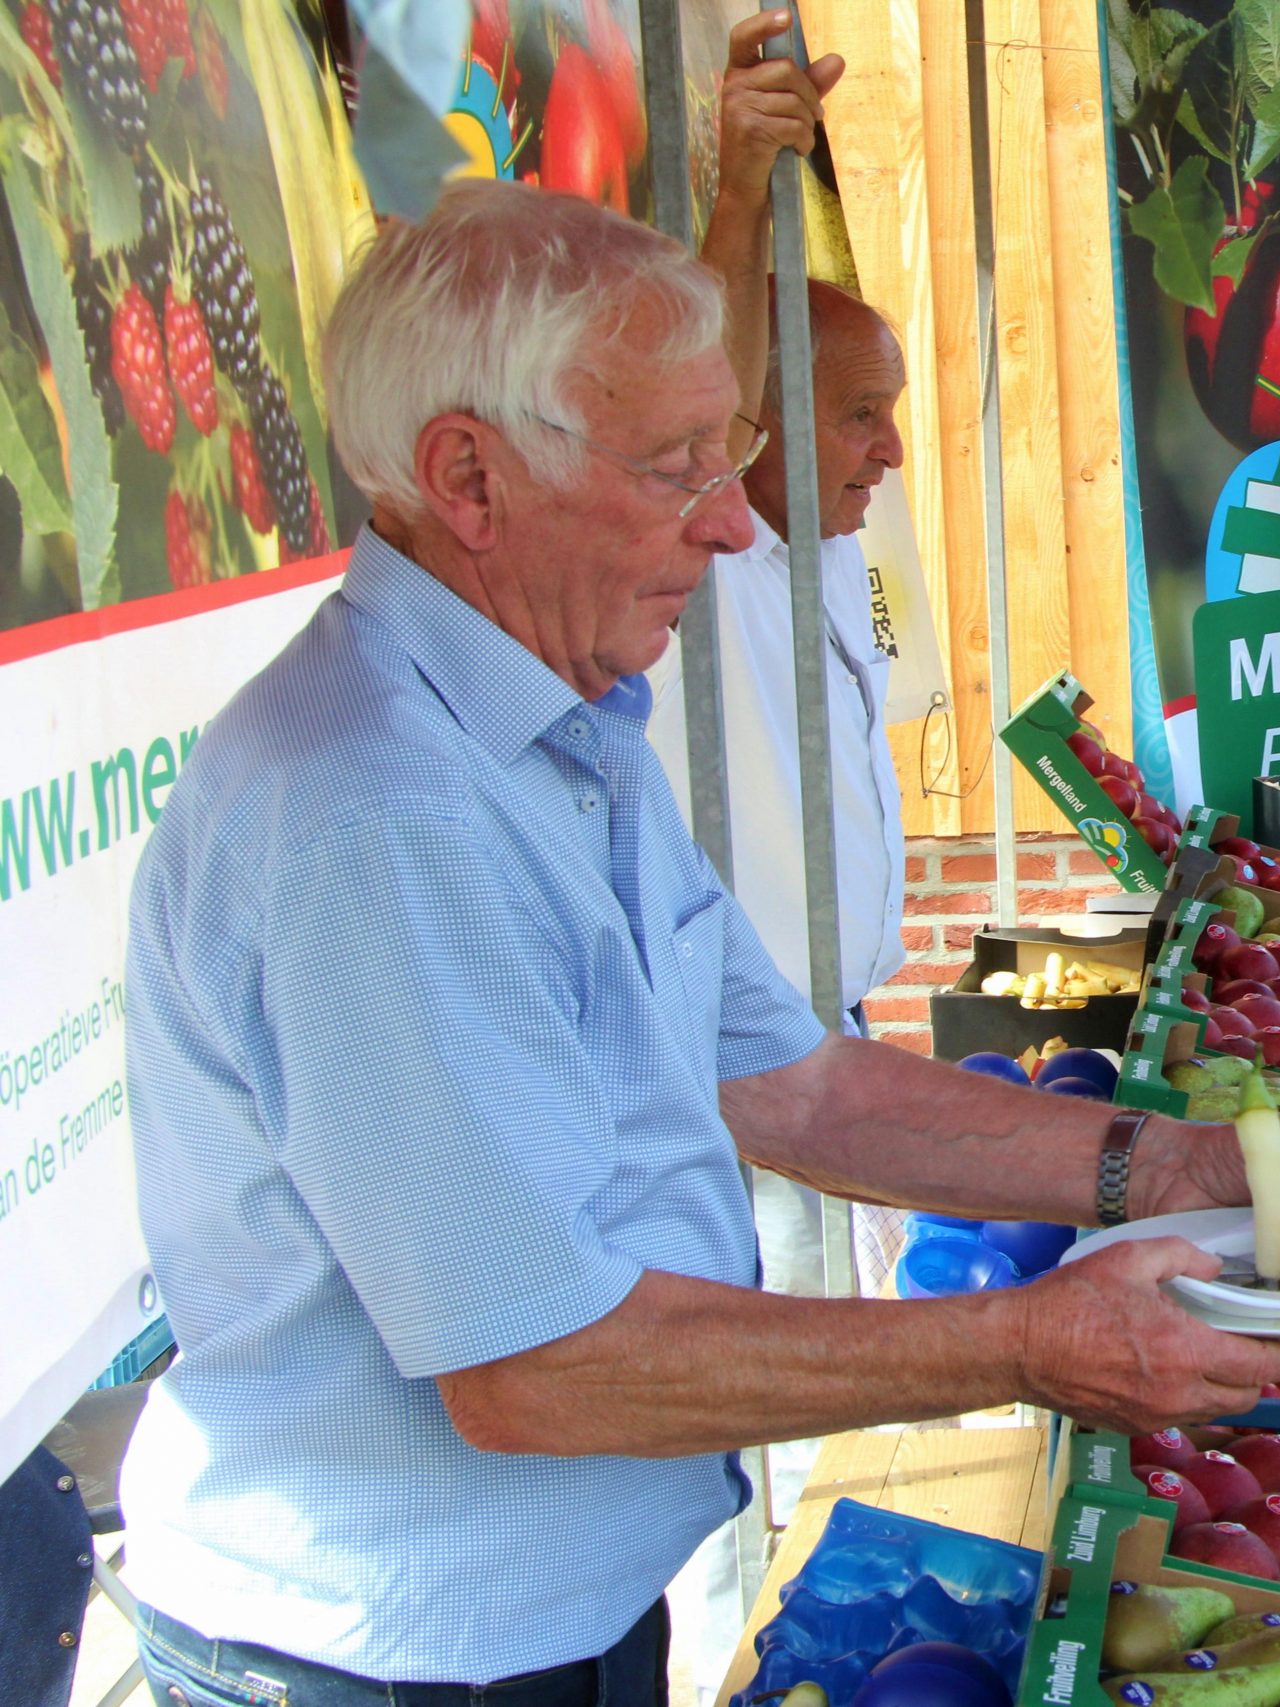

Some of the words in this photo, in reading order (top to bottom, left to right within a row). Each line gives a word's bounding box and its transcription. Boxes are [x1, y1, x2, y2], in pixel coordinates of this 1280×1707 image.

[1036, 755, 1087, 813] Mergelland
[25, 1137, 55, 1195] de
[58, 1079, 124, 1170] Fremme
[1070, 1505, 1107, 1541] Limburg
[1067, 1543, 1097, 1562] Zuid
[1043, 1639, 1086, 1705] Fruitveiling
